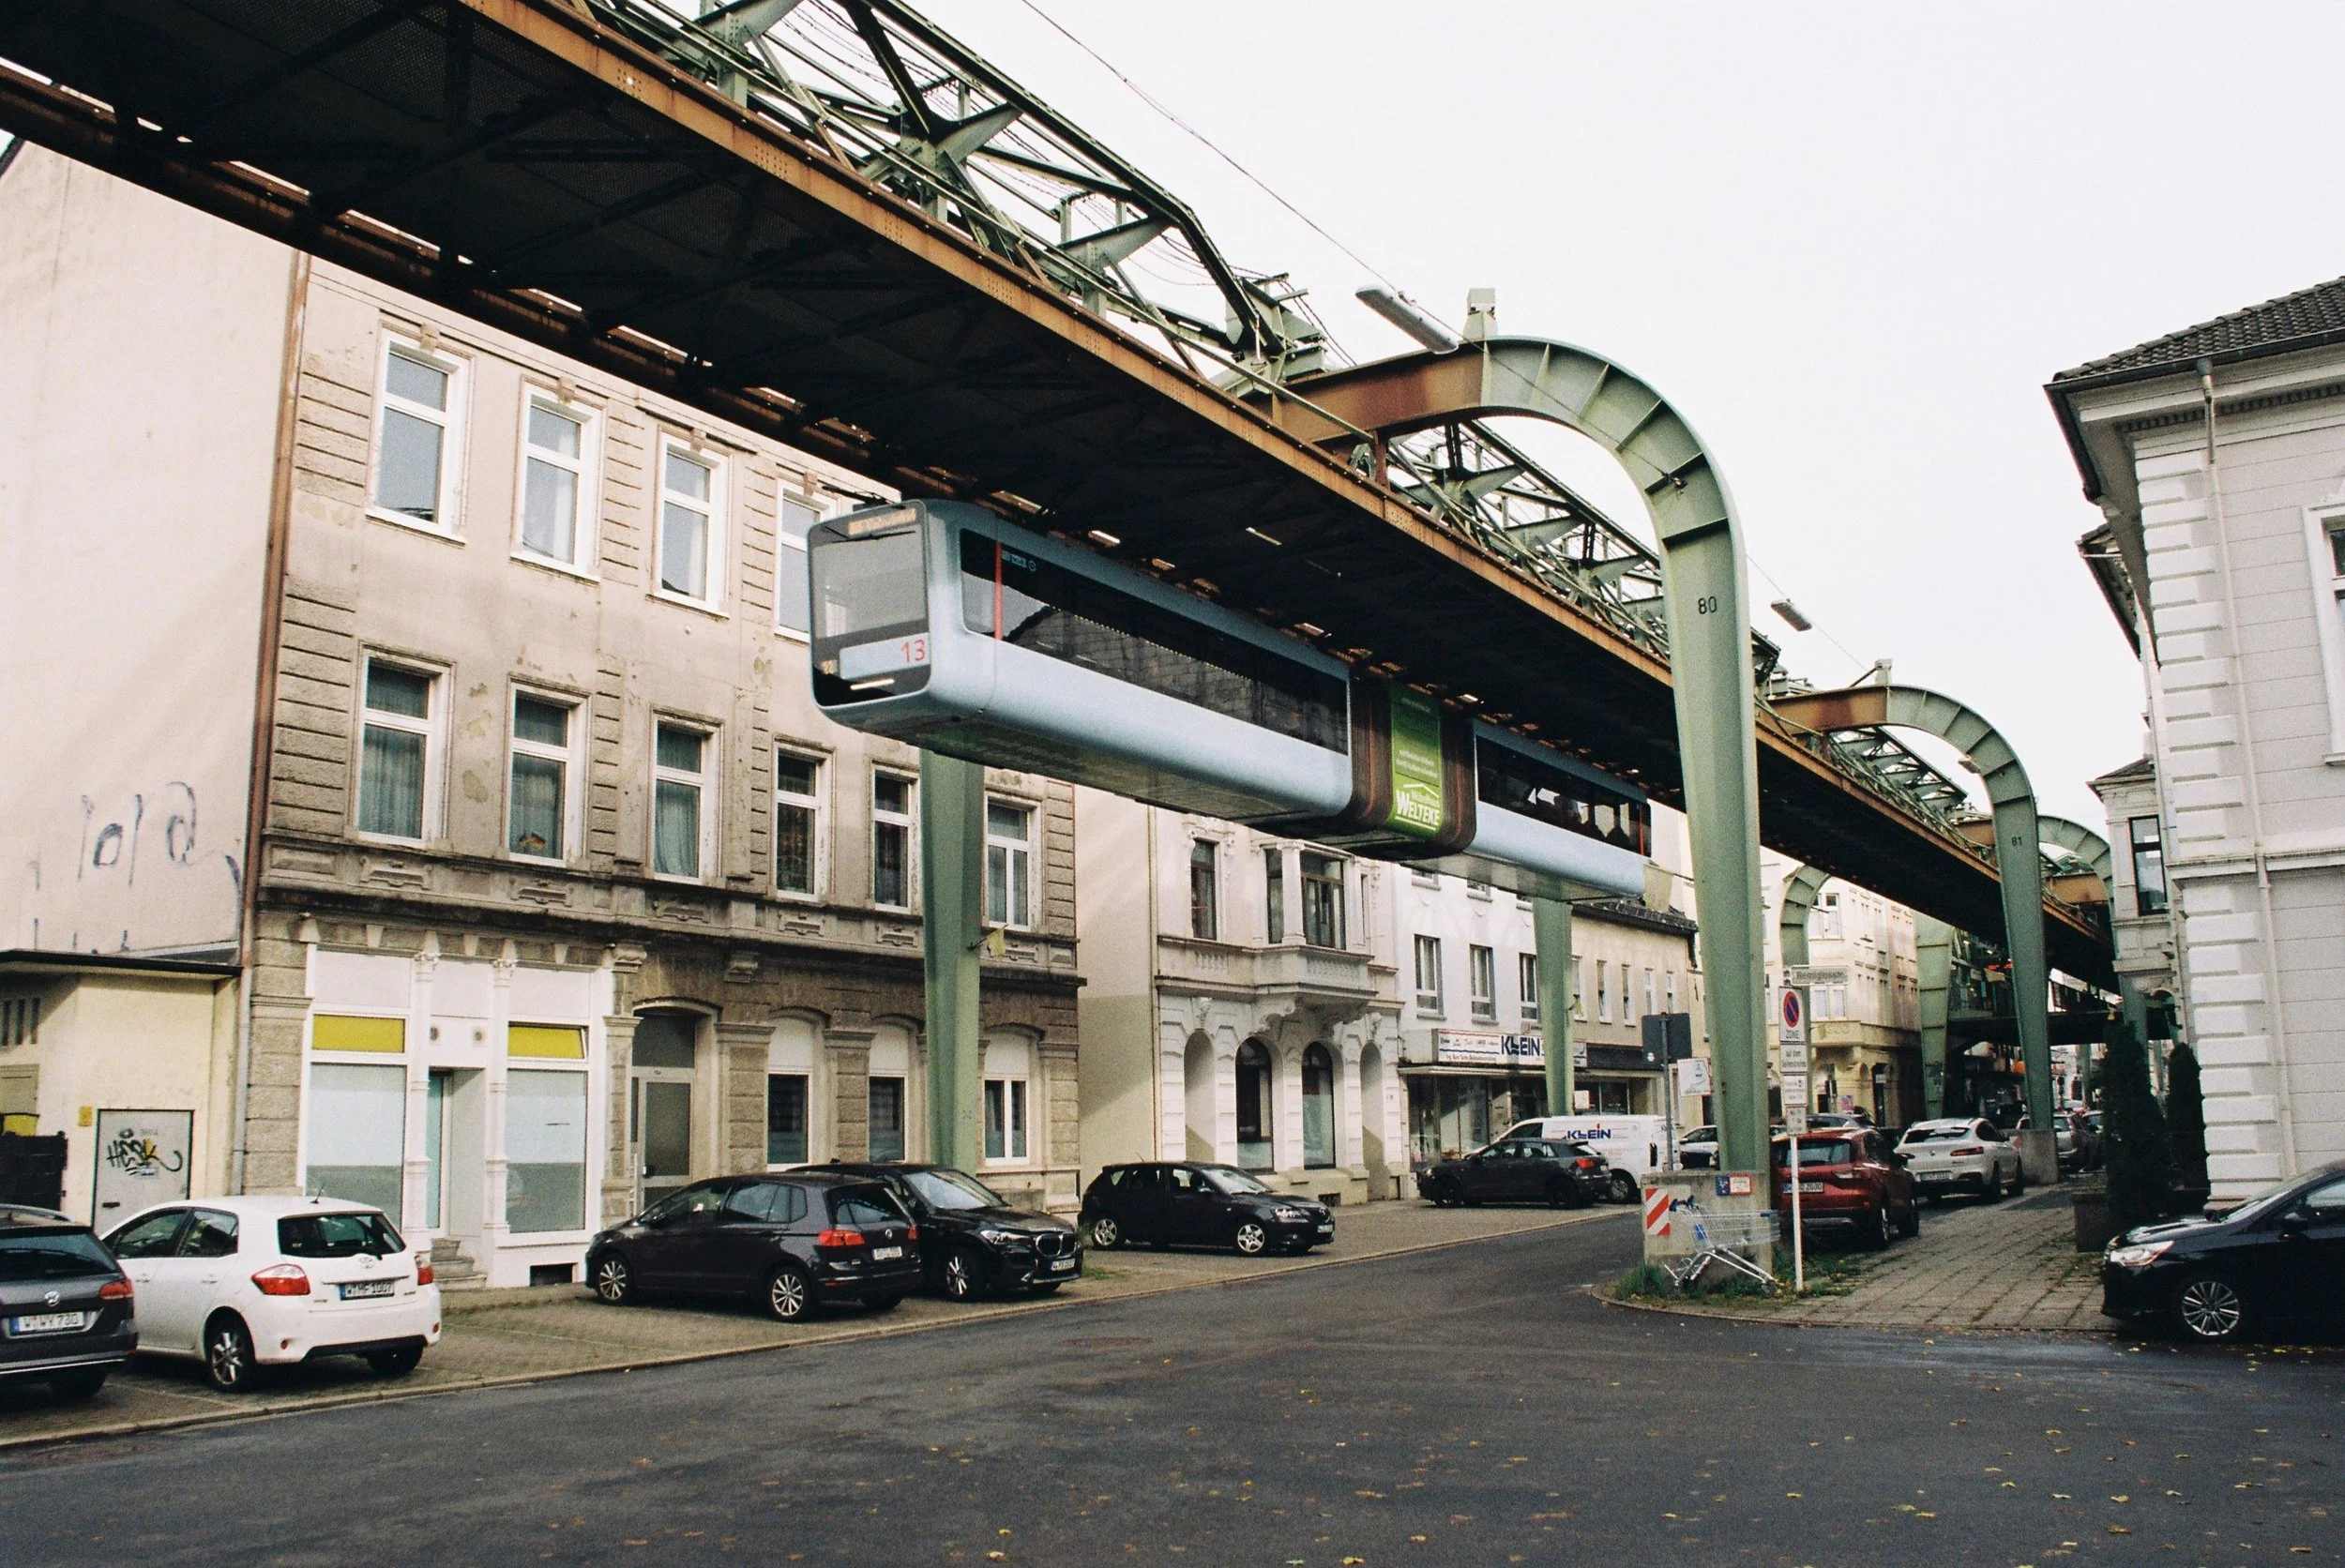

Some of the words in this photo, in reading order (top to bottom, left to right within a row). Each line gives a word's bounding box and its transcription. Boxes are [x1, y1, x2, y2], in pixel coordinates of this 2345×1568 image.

[1698, 596, 1717, 614] 80
[901, 639, 926, 663] 13
[2011, 837, 2022, 846] 81
[1786, 1029, 1800, 1039] ZONE
[1501, 1035, 1540, 1056] KLEIN
[1567, 1128, 1611, 1139] KLEIN
